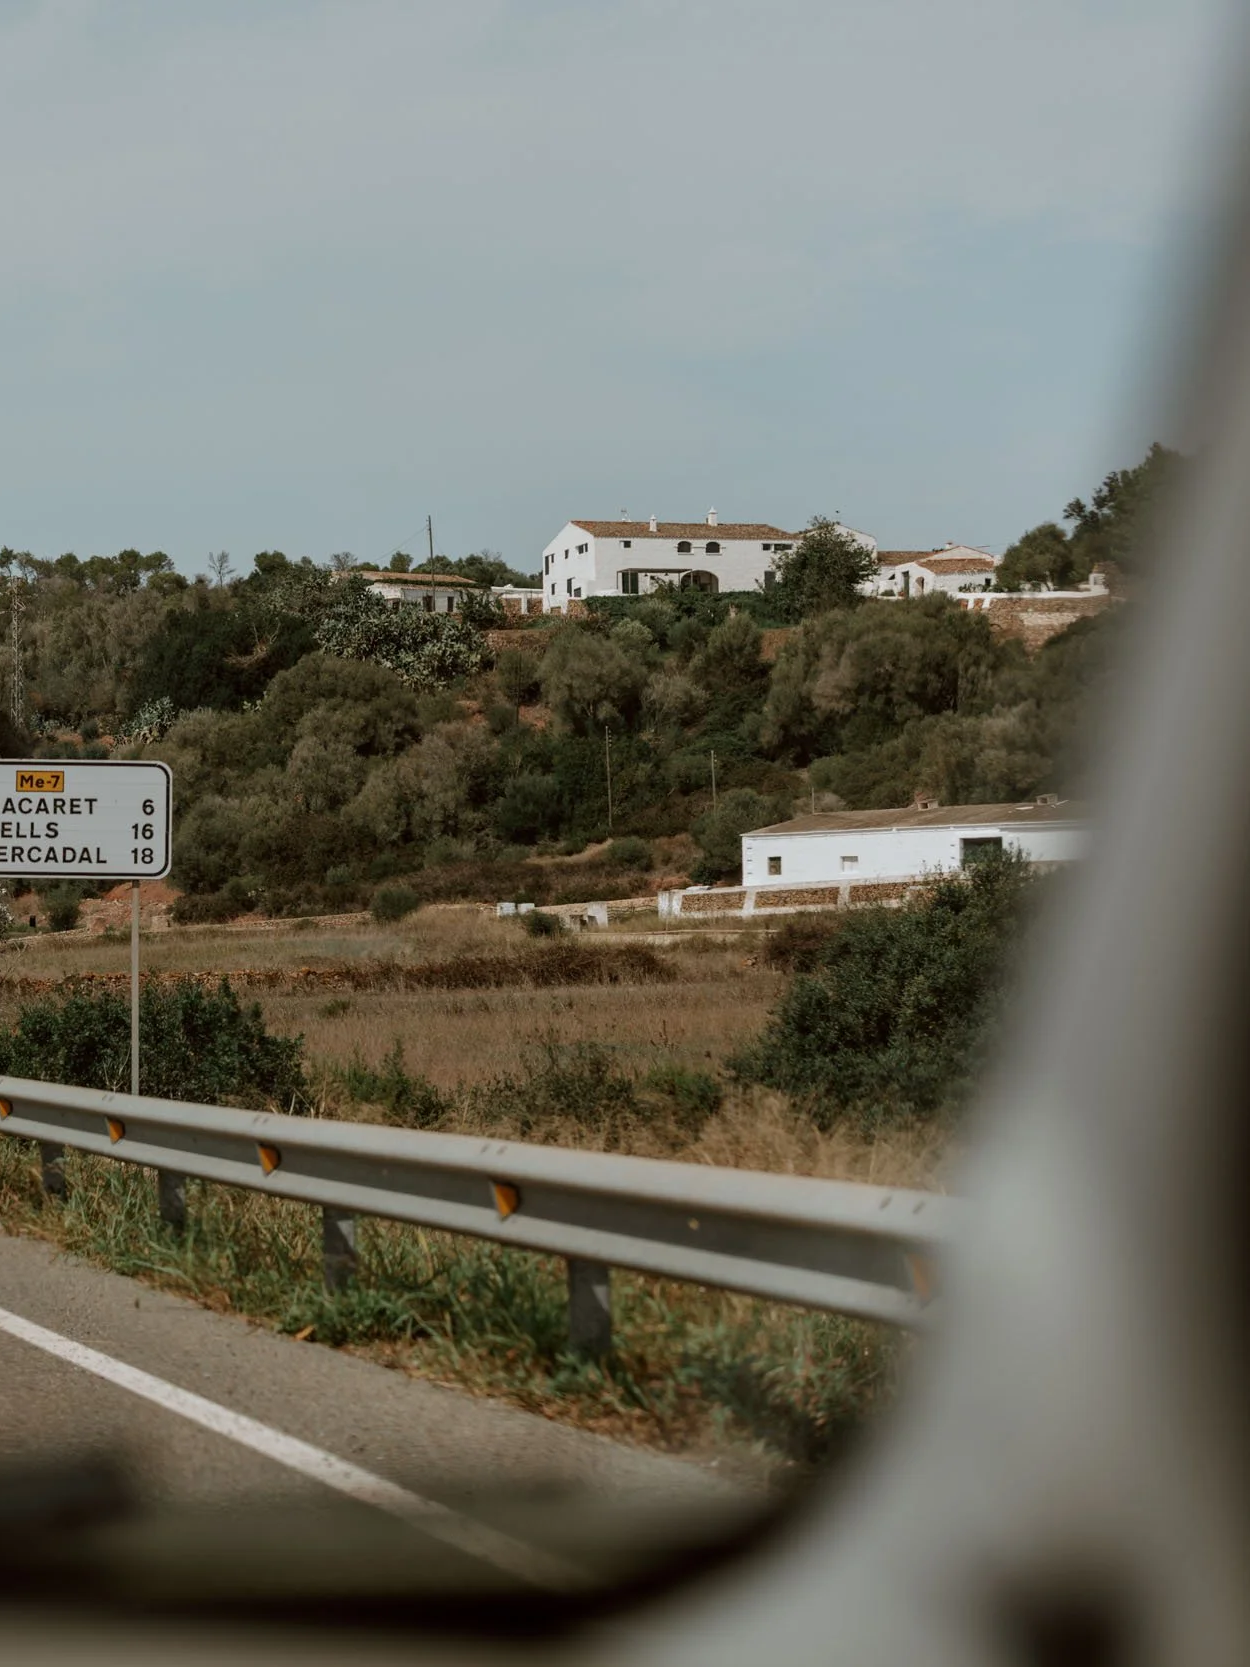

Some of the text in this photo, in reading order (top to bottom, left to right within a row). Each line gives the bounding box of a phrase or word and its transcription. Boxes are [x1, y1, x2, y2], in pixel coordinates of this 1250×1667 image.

[19, 774, 60, 789] Me-7
[142, 799, 155, 816] 6
[131, 823, 154, 840] 16
[131, 847, 154, 865] 18
